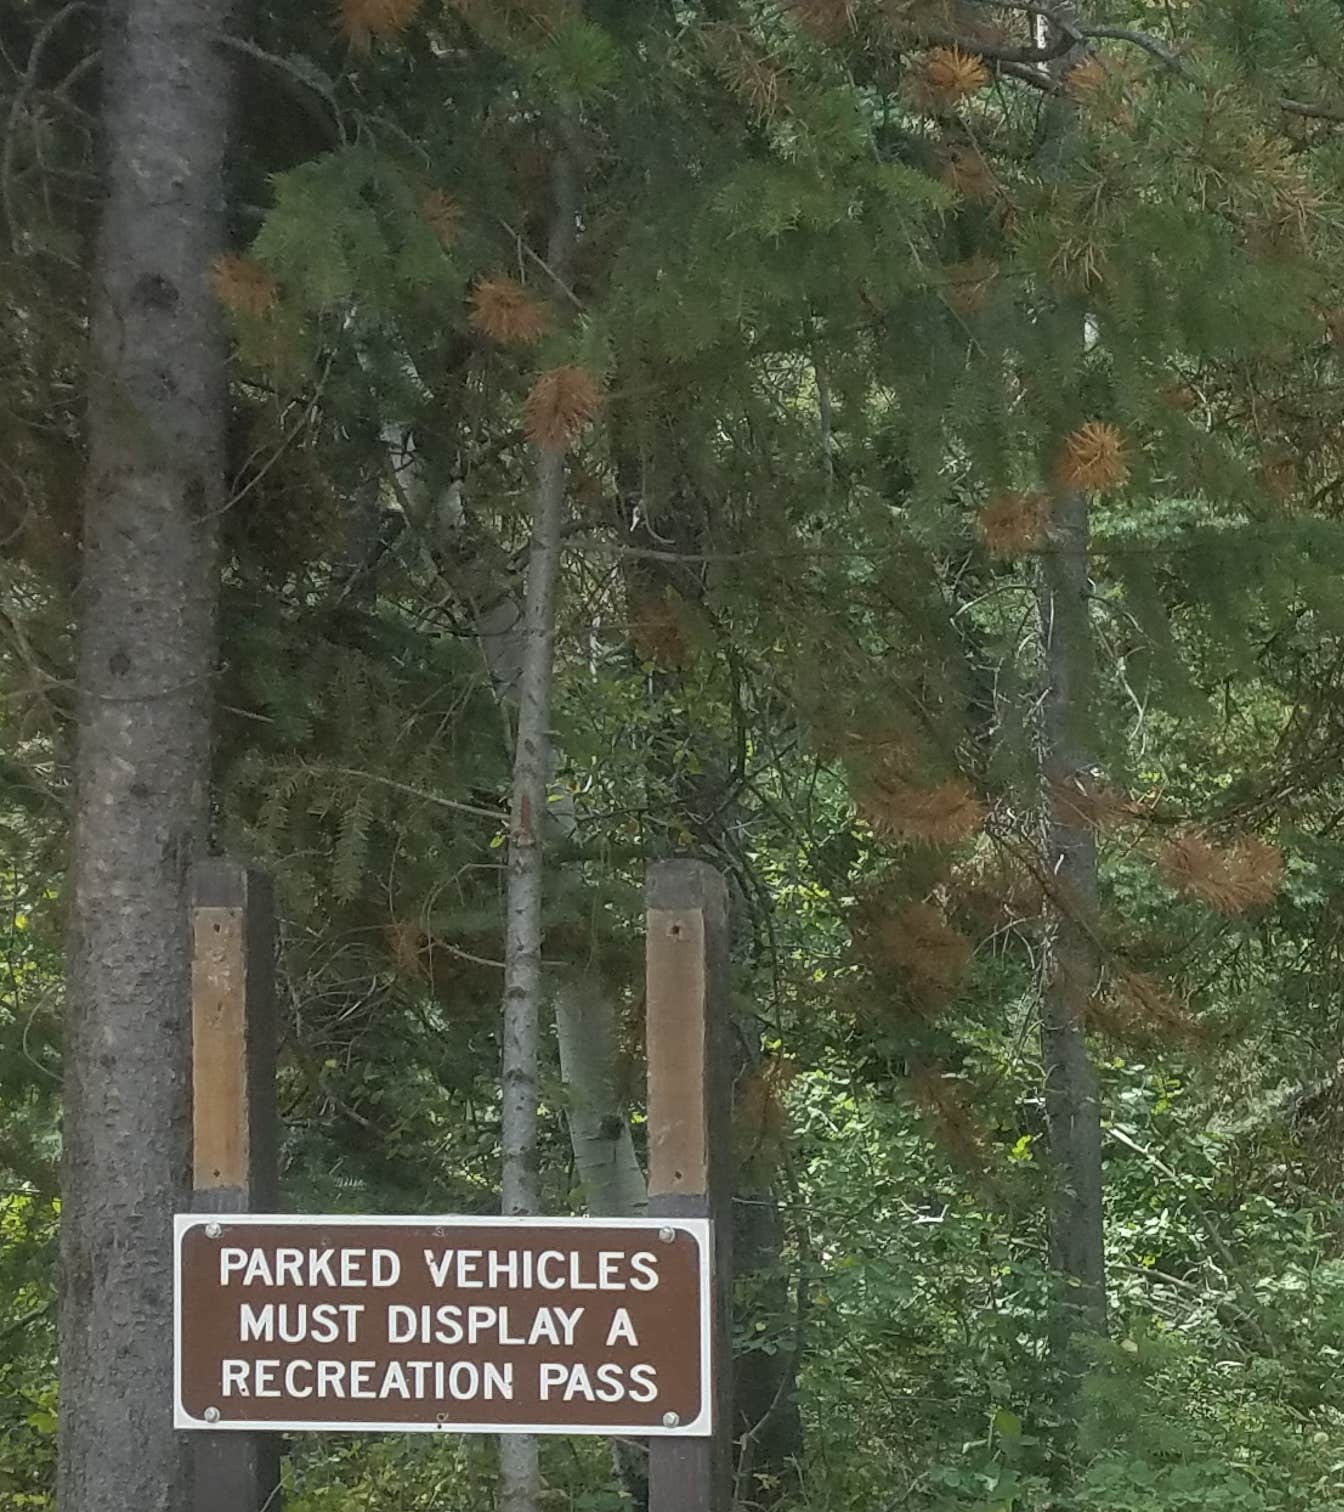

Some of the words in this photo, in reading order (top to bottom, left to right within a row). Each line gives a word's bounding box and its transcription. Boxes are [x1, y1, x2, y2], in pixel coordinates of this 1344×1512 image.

[220, 1248, 401, 1288] PARKED
[424, 1250, 659, 1291] VEHICLES
[239, 1304, 364, 1343] MUST
[387, 1305, 585, 1345] DISPLAY
[606, 1308, 638, 1346] A
[221, 1359, 513, 1400] RECREATION
[540, 1363, 659, 1402] PASS
